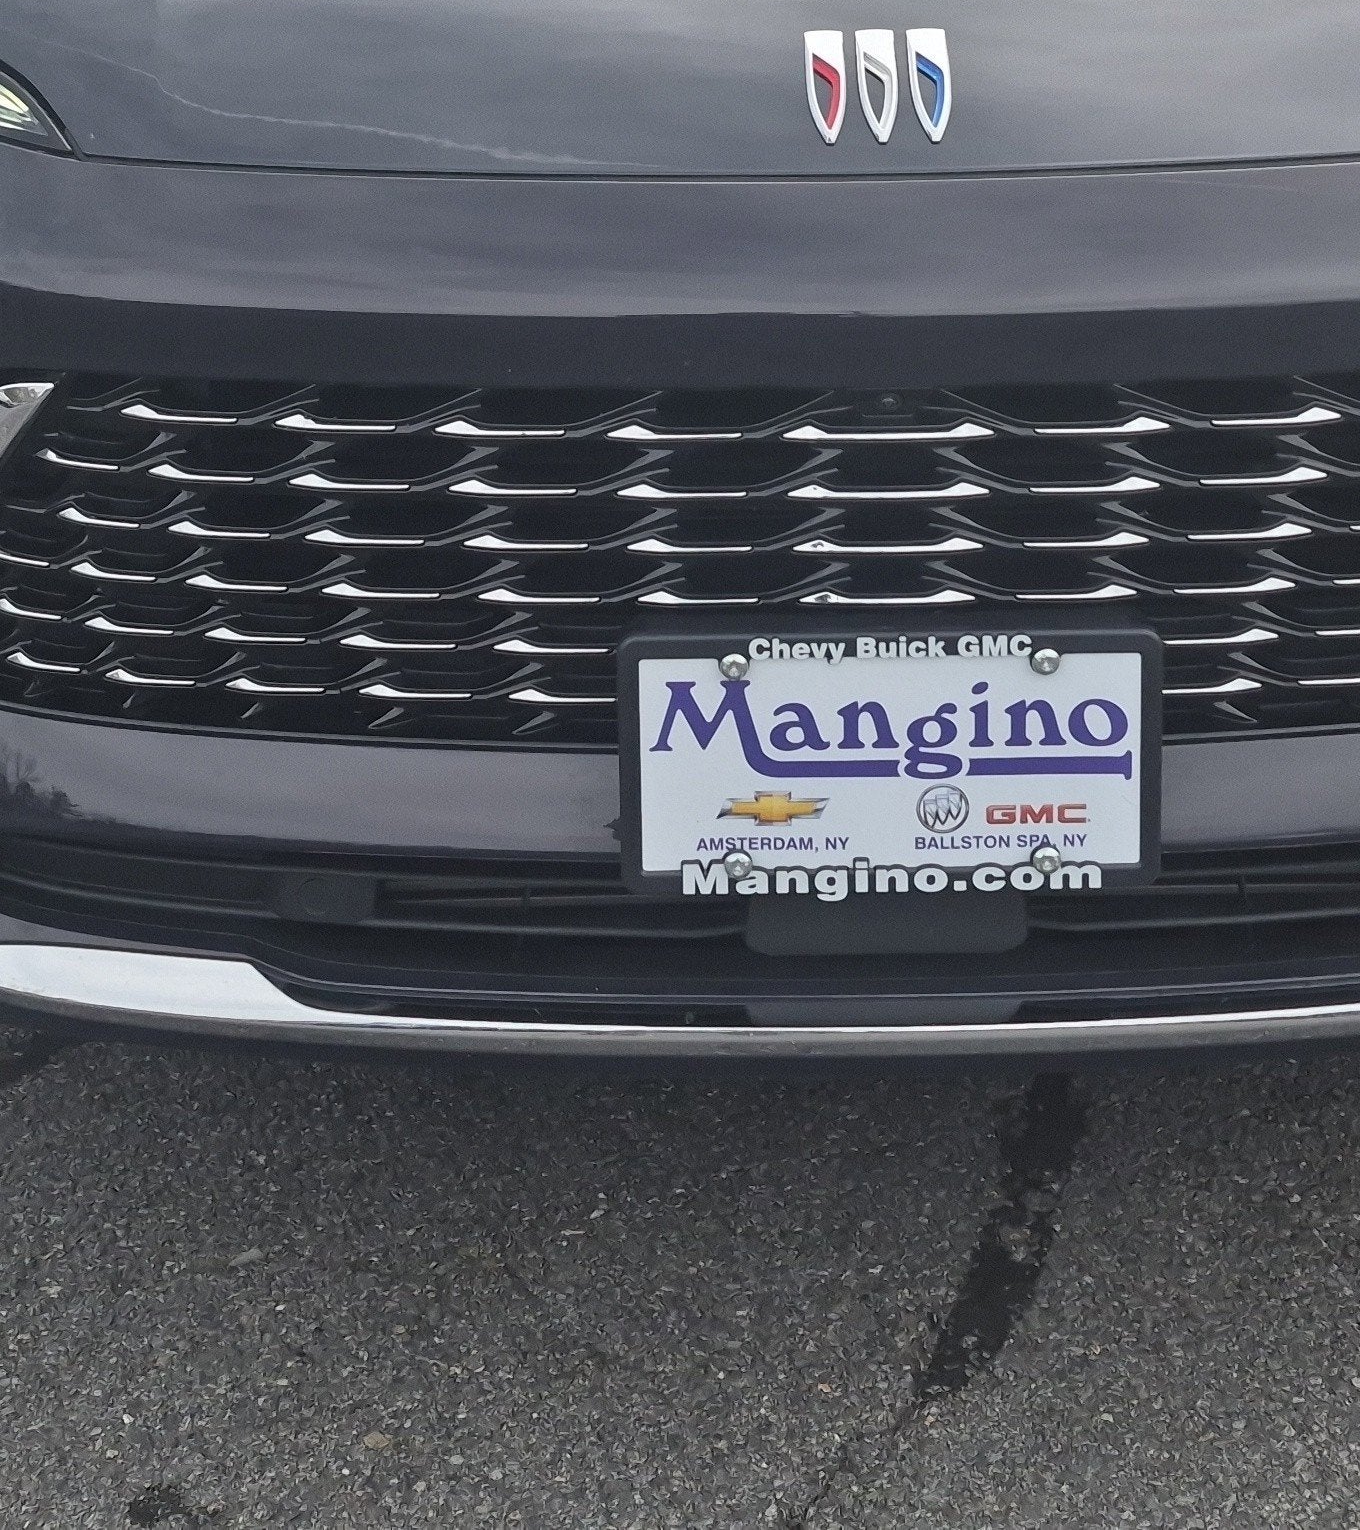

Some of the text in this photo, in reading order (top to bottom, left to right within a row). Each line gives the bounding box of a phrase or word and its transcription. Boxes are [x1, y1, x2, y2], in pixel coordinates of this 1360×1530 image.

[748, 634, 1033, 665] Chevy Buick GMC
[649, 680, 1129, 780] Mangino
[985, 803, 1088, 825] GMC
[696, 836, 850, 853] AMSTERDAM, NY
[915, 834, 1011, 850] BALLSTON
[1063, 833, 1088, 848] NY
[682, 858, 1102, 902] Mangino.com
